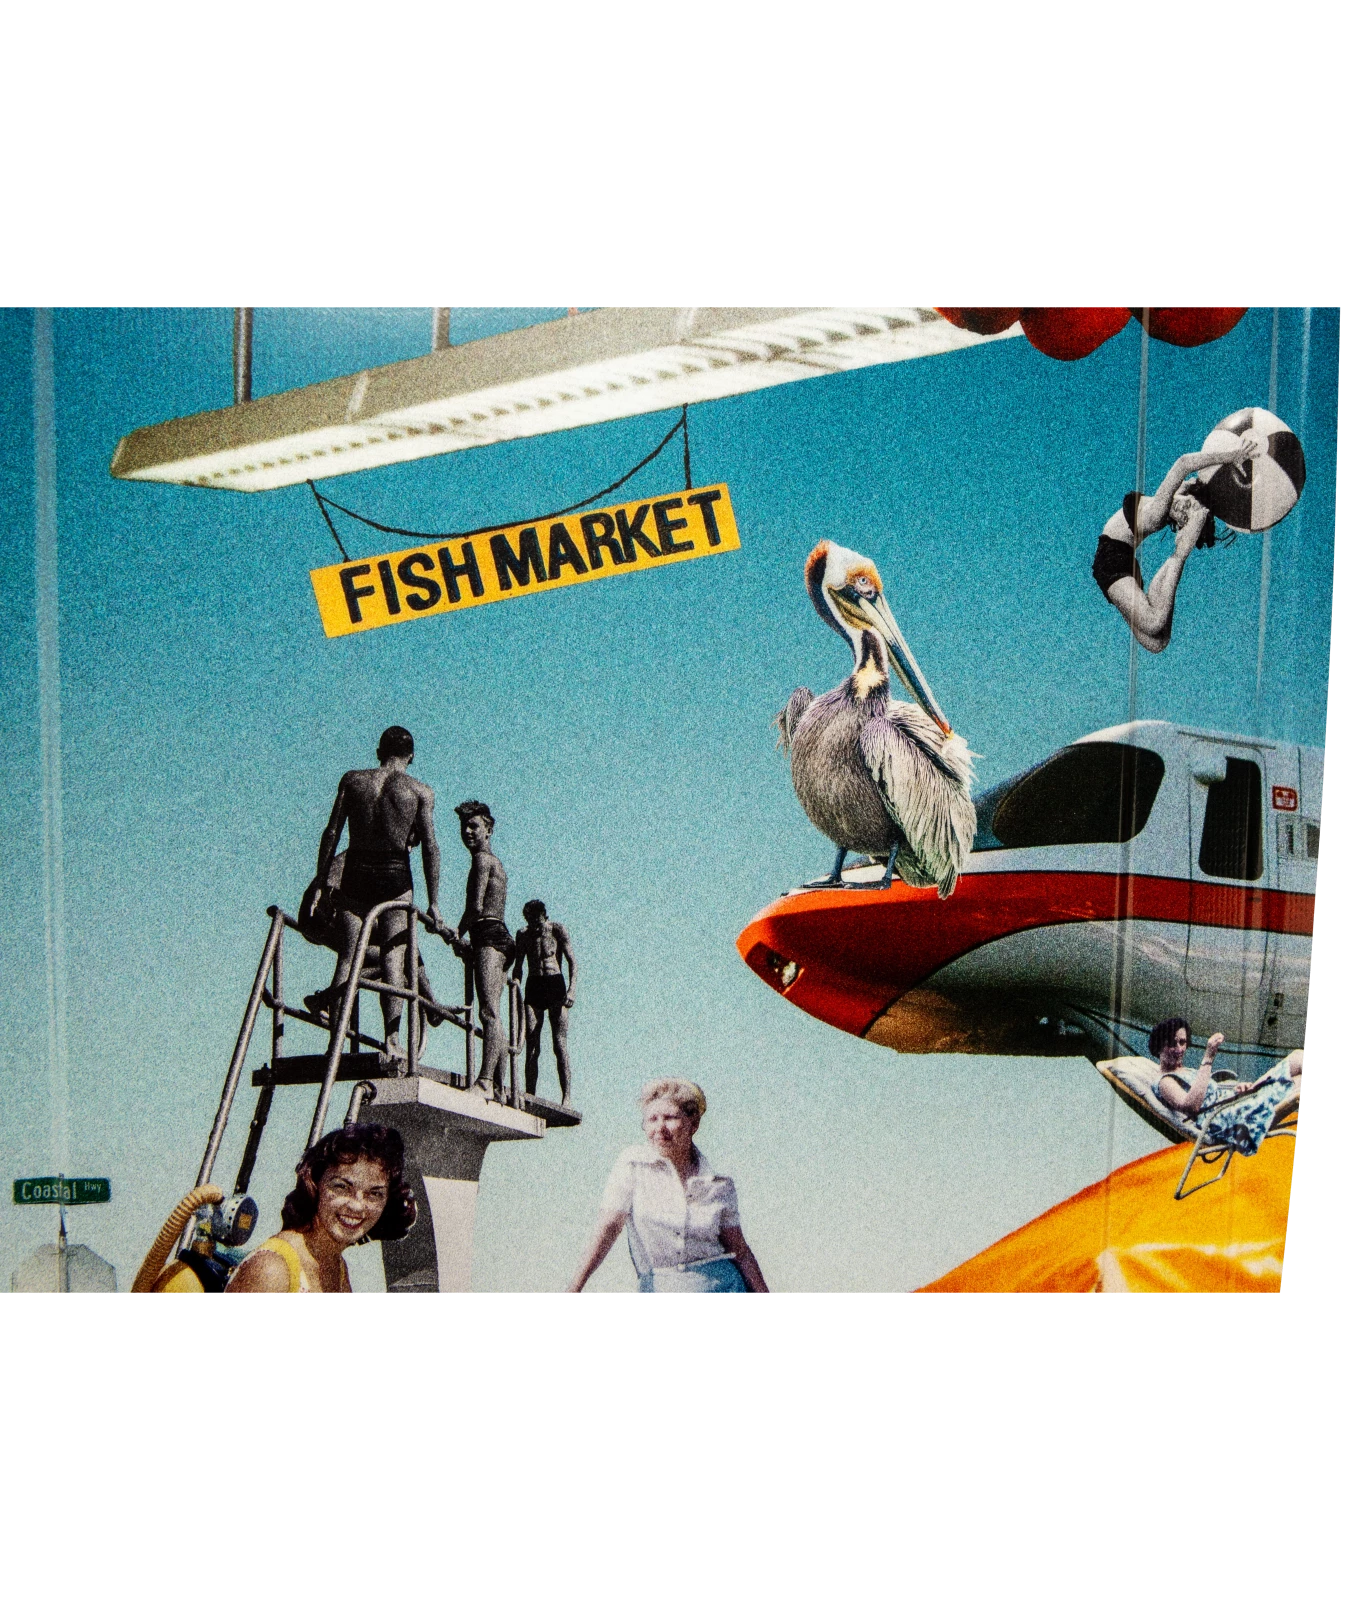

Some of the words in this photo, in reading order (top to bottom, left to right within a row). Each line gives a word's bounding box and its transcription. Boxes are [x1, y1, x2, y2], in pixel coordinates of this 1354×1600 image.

[338, 541, 485, 624] FISH
[489, 489, 722, 591] MARKET
[21, 1181, 77, 1200] Coastal
[84, 1181, 102, 1193] Hwy
